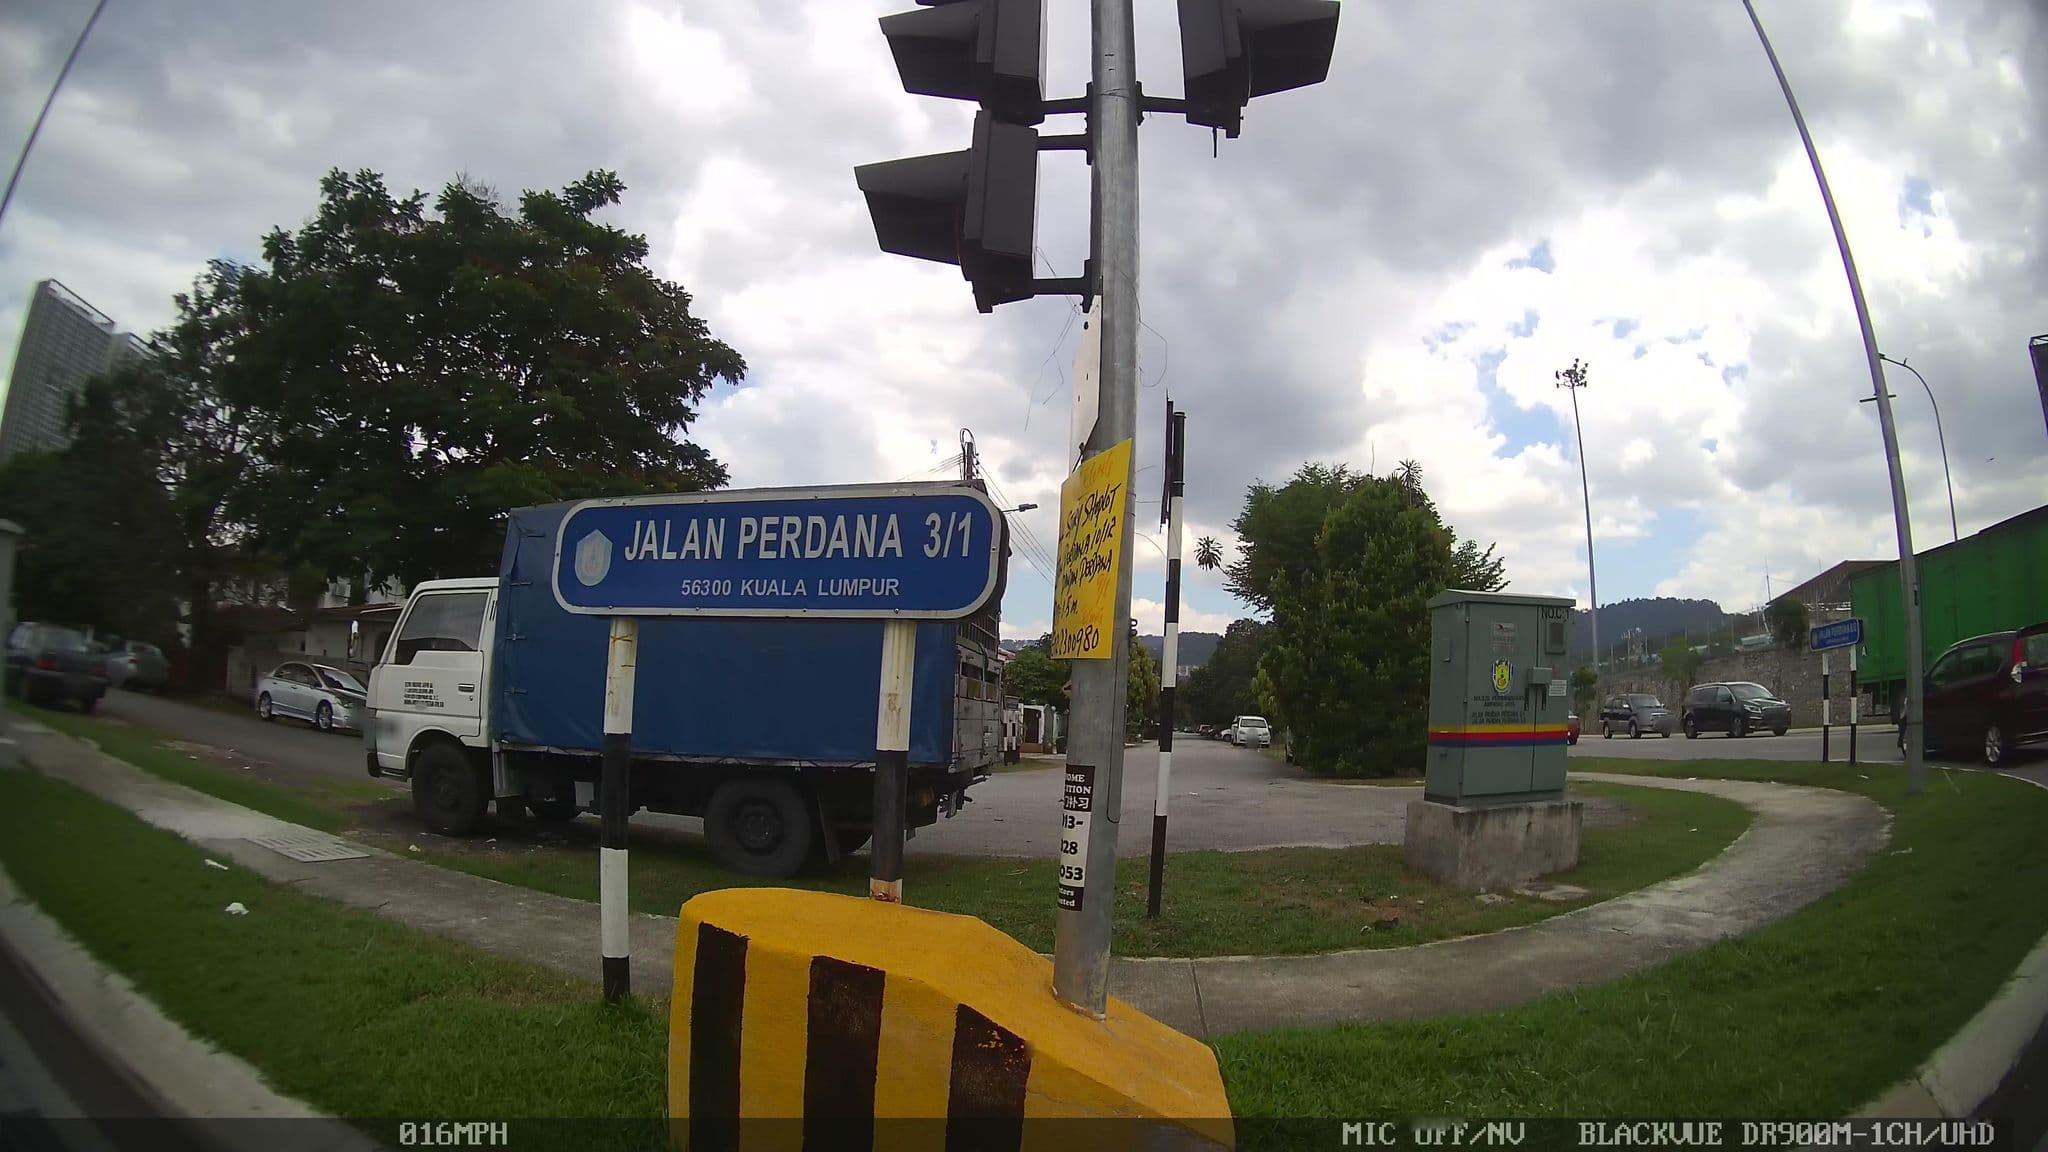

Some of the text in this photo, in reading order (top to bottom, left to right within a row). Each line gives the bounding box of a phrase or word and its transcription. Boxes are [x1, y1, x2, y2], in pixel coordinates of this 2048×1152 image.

[625, 512, 973, 561] JALAN PERDANA 3/1
[681, 578, 900, 597] 56300 KUALA LUMPUR
